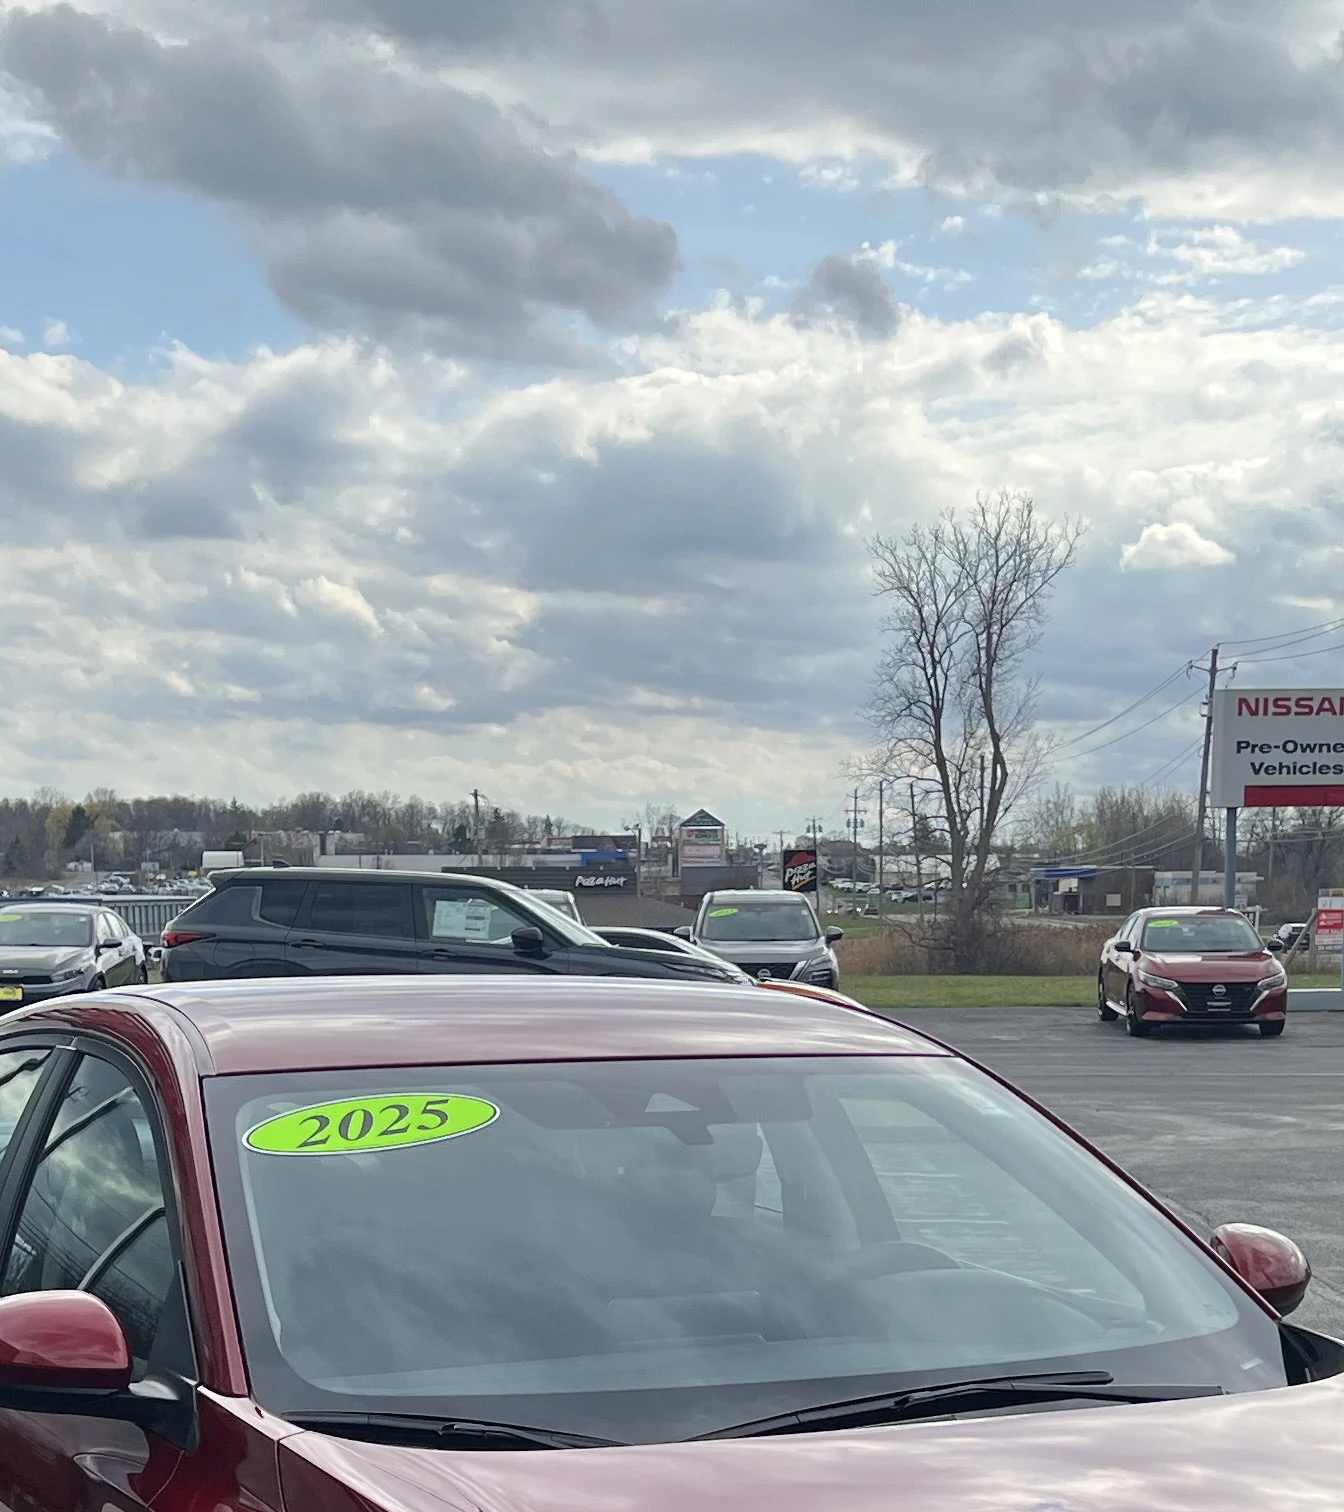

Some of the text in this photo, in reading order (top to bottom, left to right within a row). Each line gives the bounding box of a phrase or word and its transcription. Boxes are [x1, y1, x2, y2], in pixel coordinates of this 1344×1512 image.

[1250, 761, 1344, 775] Vehicles
[575, 876, 627, 888] Pizza Hut
[296, 1098, 449, 1149] 2025
